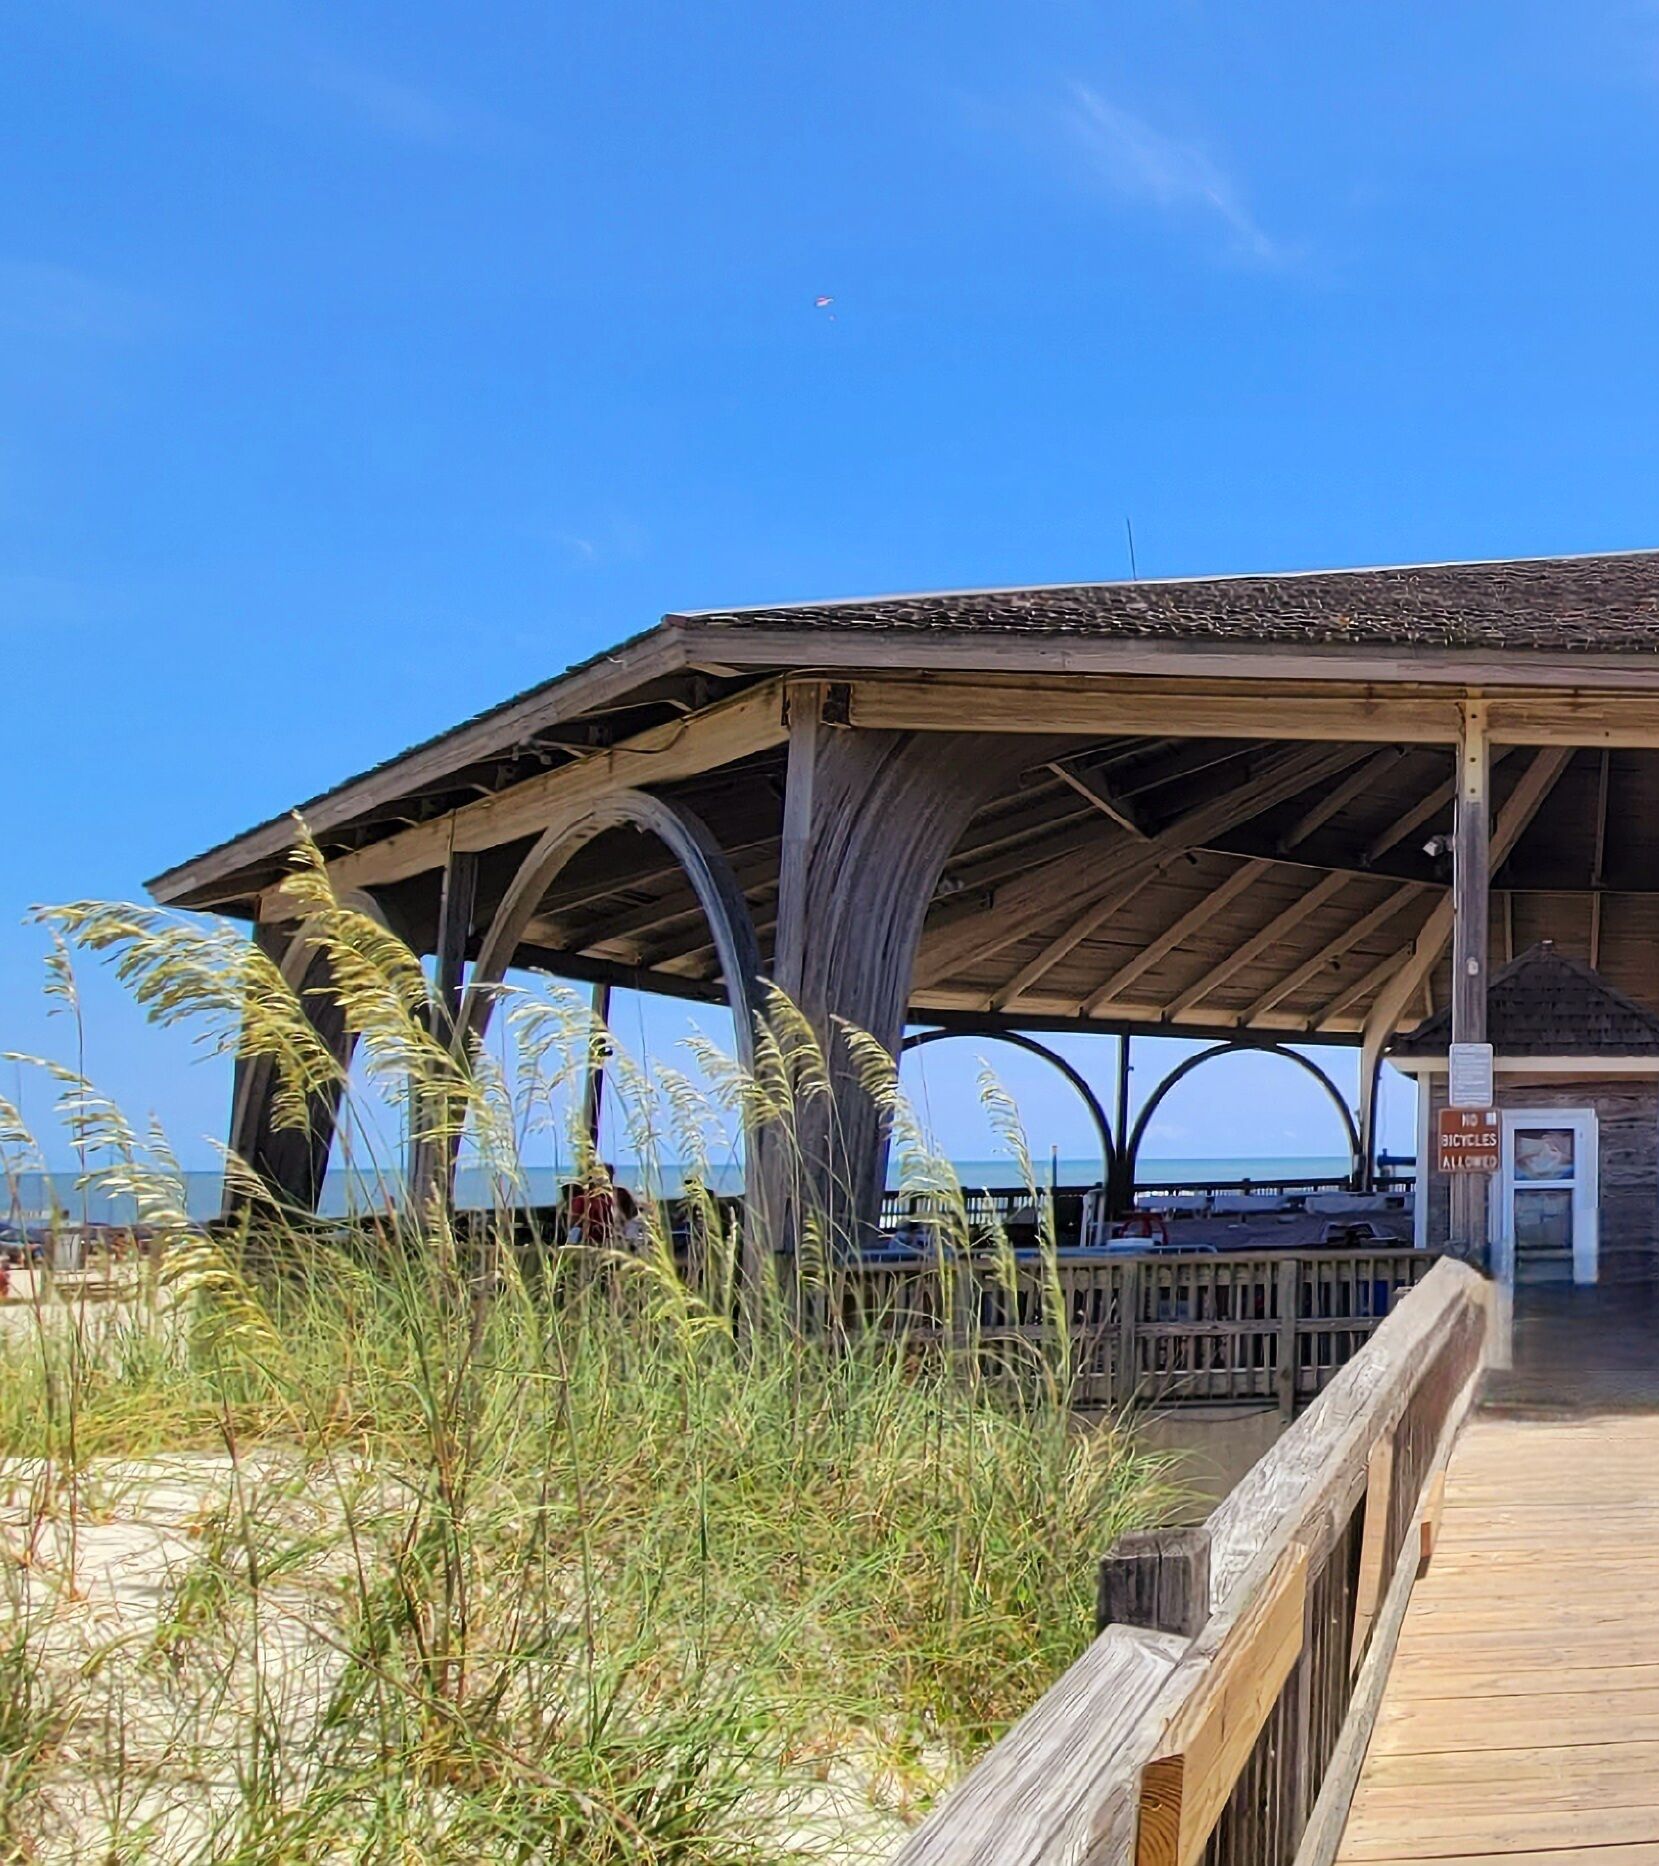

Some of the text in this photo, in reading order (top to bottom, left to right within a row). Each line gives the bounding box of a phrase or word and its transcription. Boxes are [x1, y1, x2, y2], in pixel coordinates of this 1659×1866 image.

[1462, 1113, 1478, 1127] NO
[1441, 1133, 1497, 1147] BICYCLES
[1443, 1155, 1497, 1169] ALLOWED
